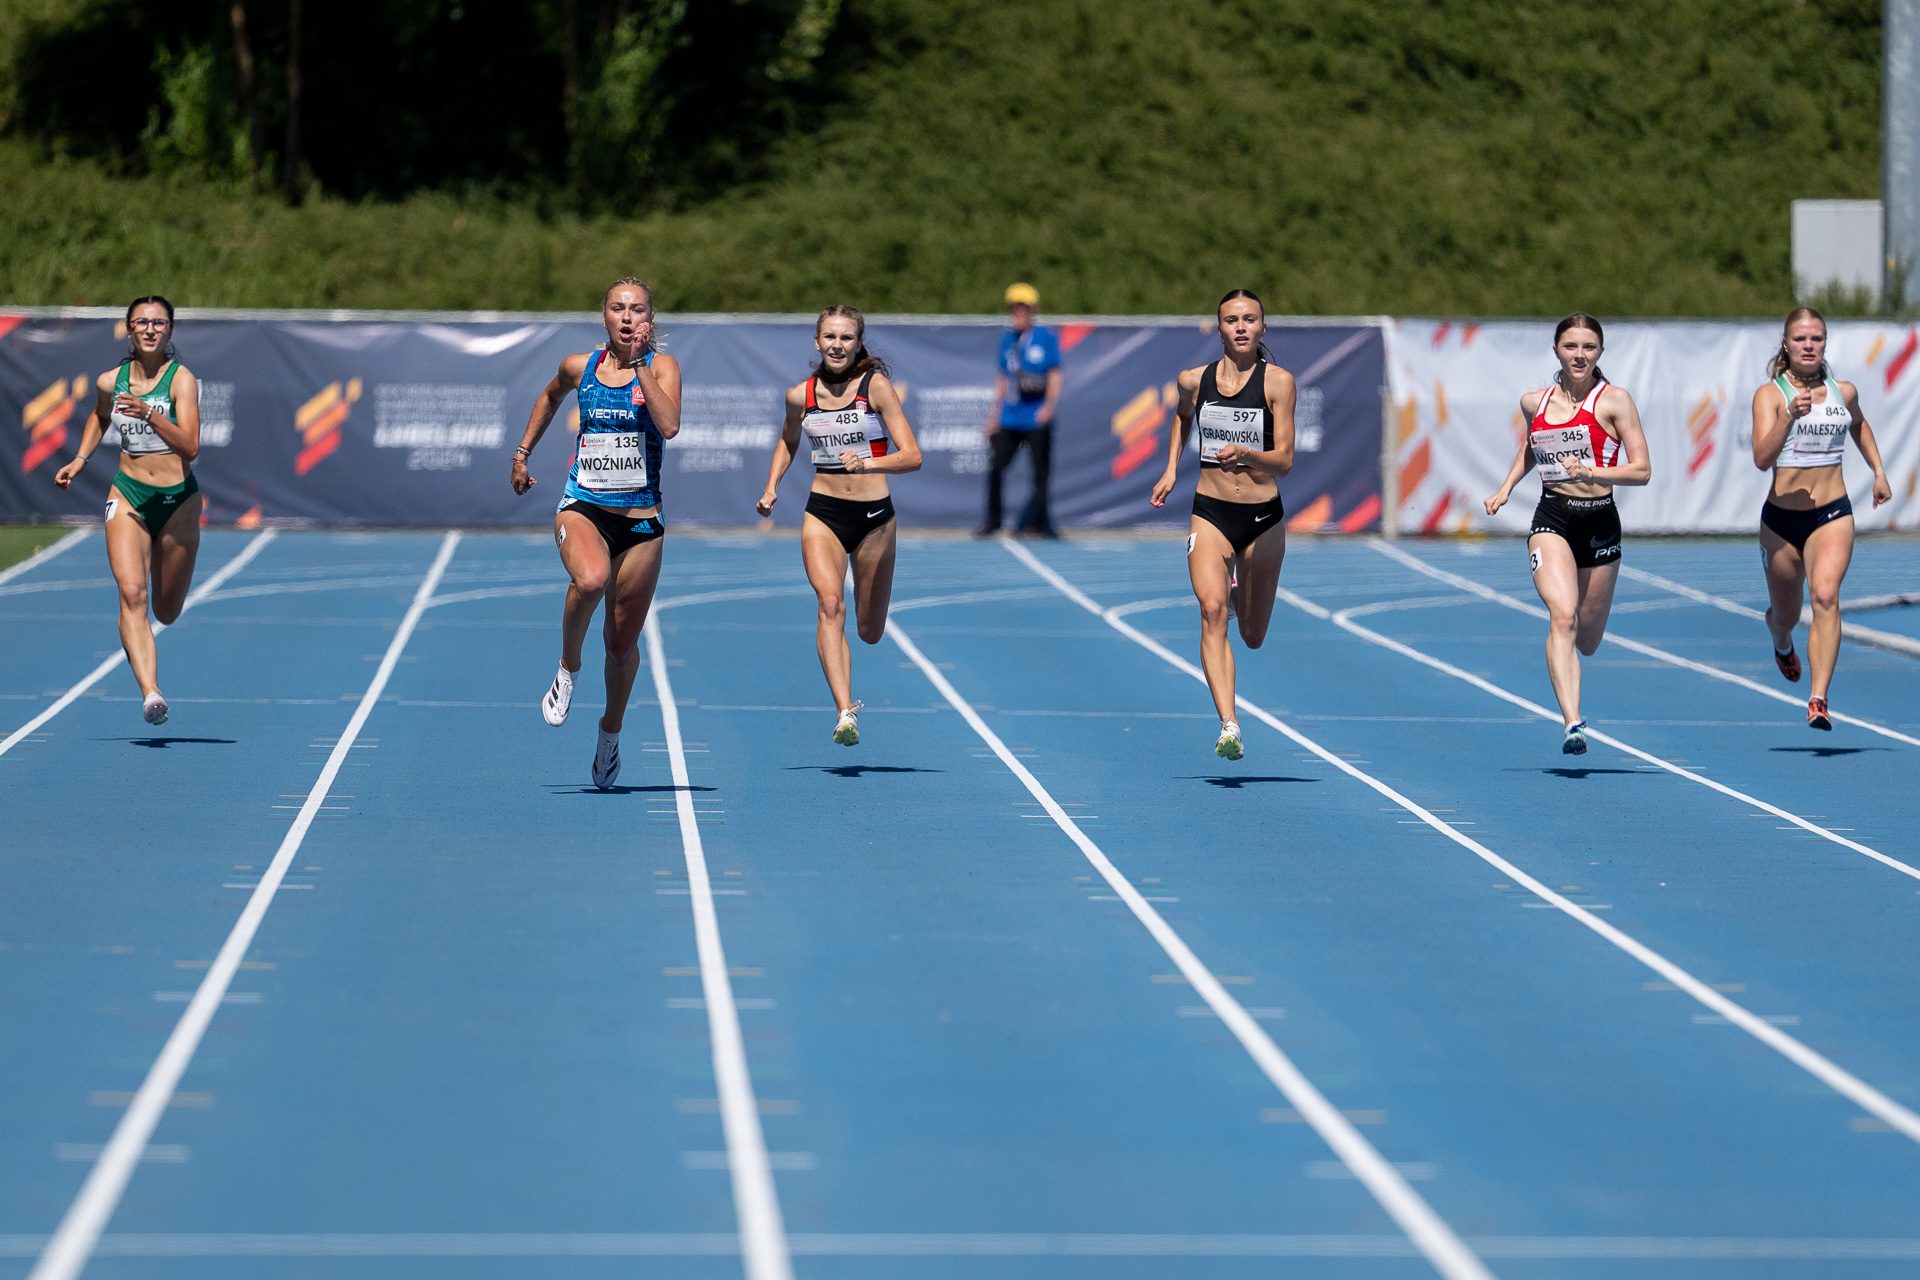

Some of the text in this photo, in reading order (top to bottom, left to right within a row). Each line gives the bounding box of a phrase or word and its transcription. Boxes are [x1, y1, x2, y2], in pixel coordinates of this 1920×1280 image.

[588, 408, 635, 420] VECTRA
[1232, 410, 1257, 423] 597
[1825, 406, 1846, 417] 843
[836, 412, 859, 425] 483
[120, 423, 155, 436] GŁUC
[1202, 427, 1260, 444] GRABOWSKA
[1561, 429, 1584, 443] 345
[1797, 423, 1848, 436] MALESZKA
[614, 436, 639, 448] 135
[580, 454, 643, 471] WOŹNIAK
[1567, 497, 1611, 508] NIKE PRO
[105, 501, 114, 521] 7
[630, 526, 655, 534] adidas
[1530, 553, 1538, 572] 3
